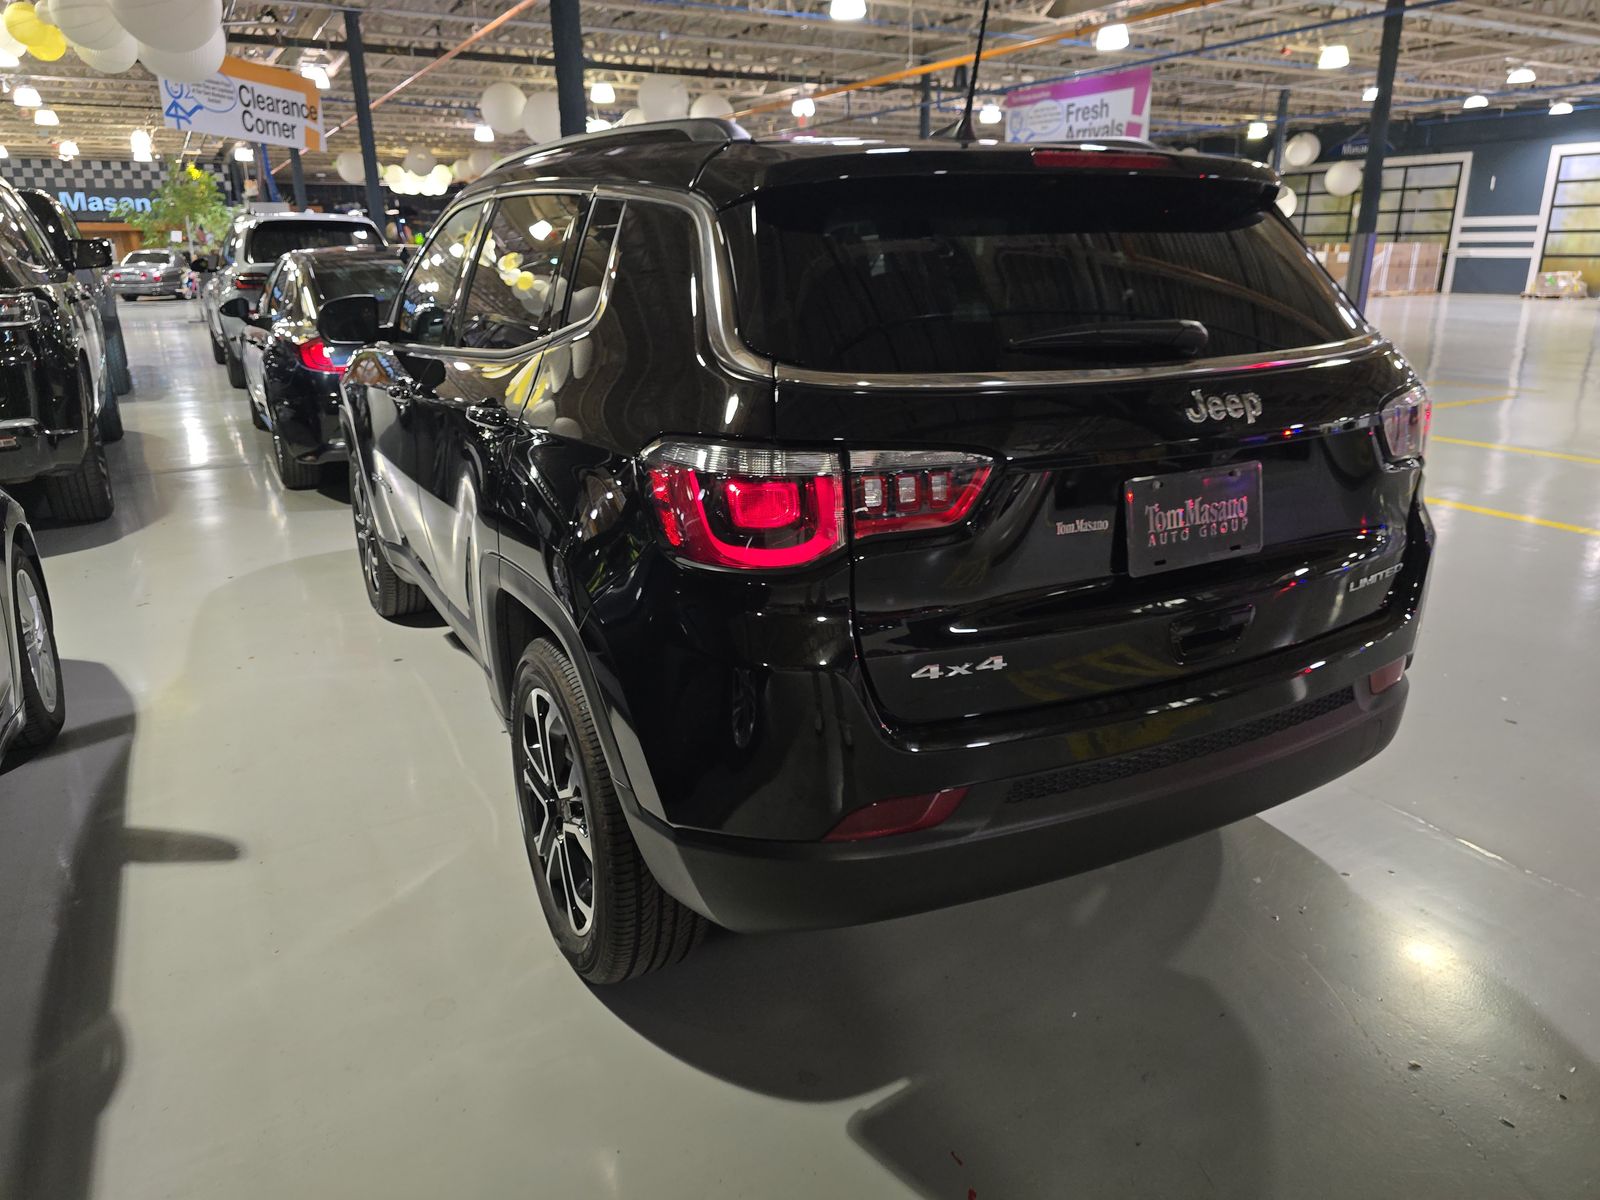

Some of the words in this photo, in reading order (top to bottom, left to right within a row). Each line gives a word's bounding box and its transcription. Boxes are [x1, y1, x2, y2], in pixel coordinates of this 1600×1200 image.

[239, 85, 318, 121] Clearance
[1066, 98, 1109, 123] Fresh
[242, 110, 297, 140] Corner
[58, 191, 161, 213] Masan
[1185, 388, 1263, 425] Jeep
[1148, 527, 1190, 547] AUTO
[1199, 517, 1248, 538] GROUP
[1348, 562, 1404, 592] LIMITED
[911, 655, 1008, 679] 4x4
